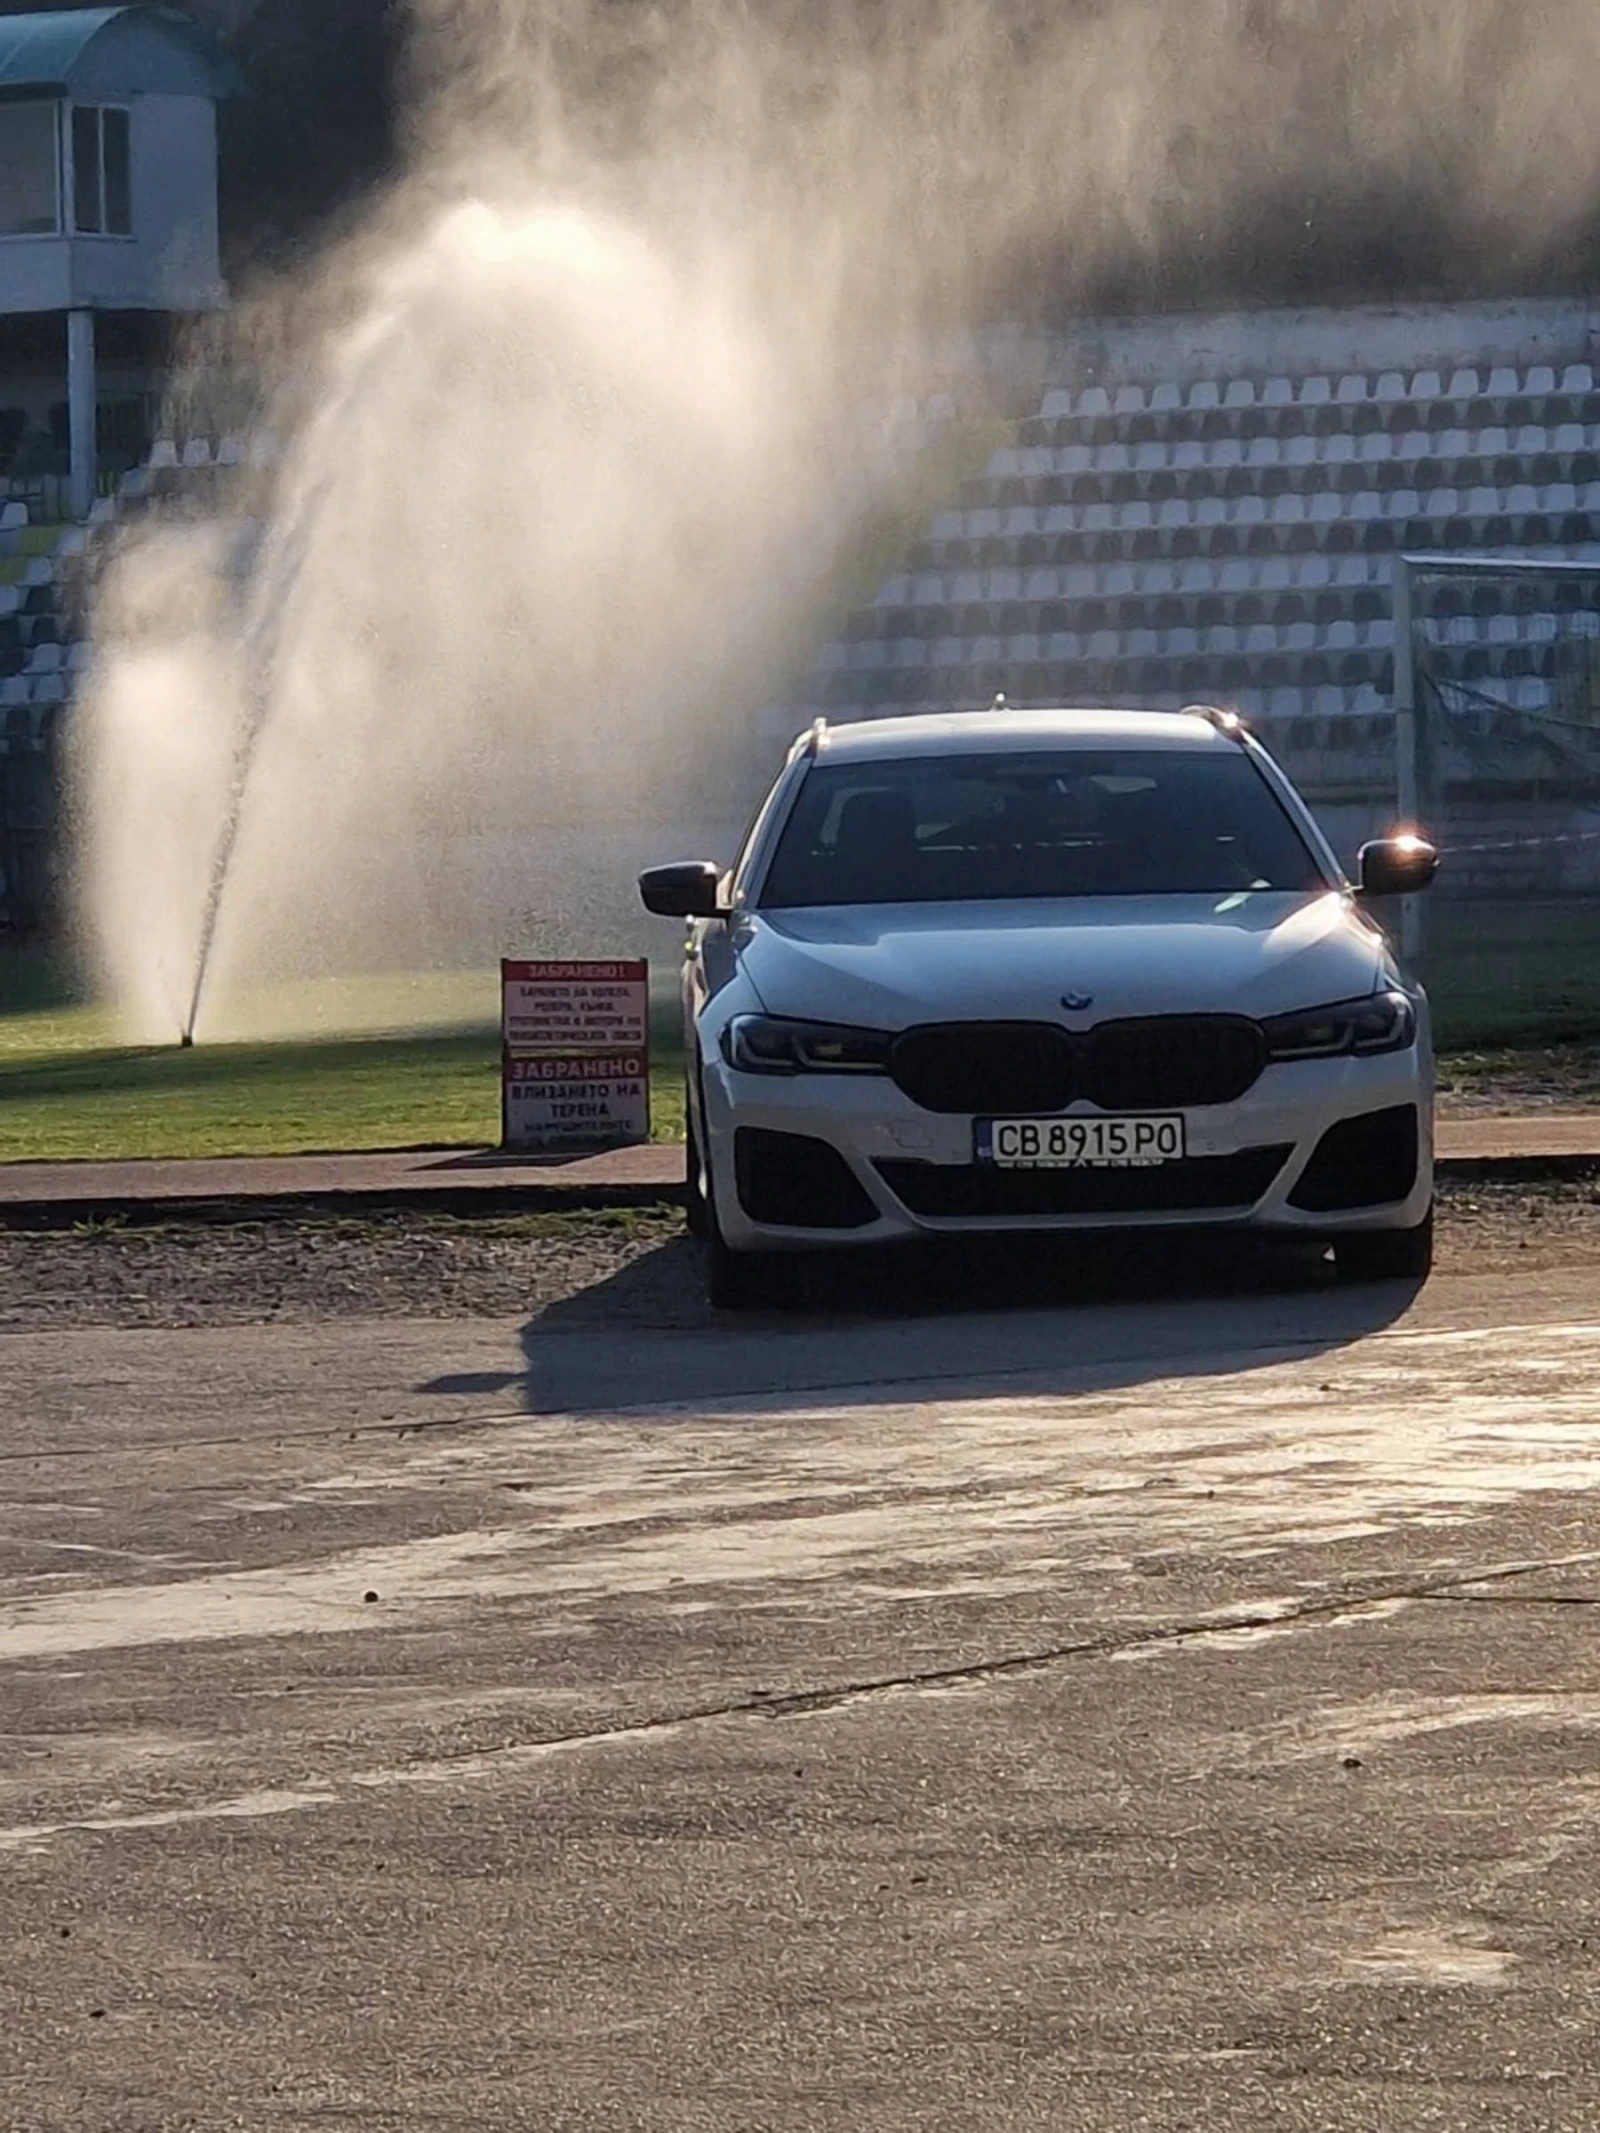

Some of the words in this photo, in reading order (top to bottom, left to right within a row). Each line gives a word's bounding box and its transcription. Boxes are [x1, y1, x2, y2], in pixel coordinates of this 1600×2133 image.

[512, 1058, 640, 1079] ЗАБРАНЕНО
[511, 1084, 609, 1100] ВЛИЗАНЕТО
[616, 1083, 641, 1097] НА
[551, 1103, 610, 1118] ТЕРЕНА
[999, 1125, 1041, 1156] CB
[1048, 1123, 1128, 1155] 8915
